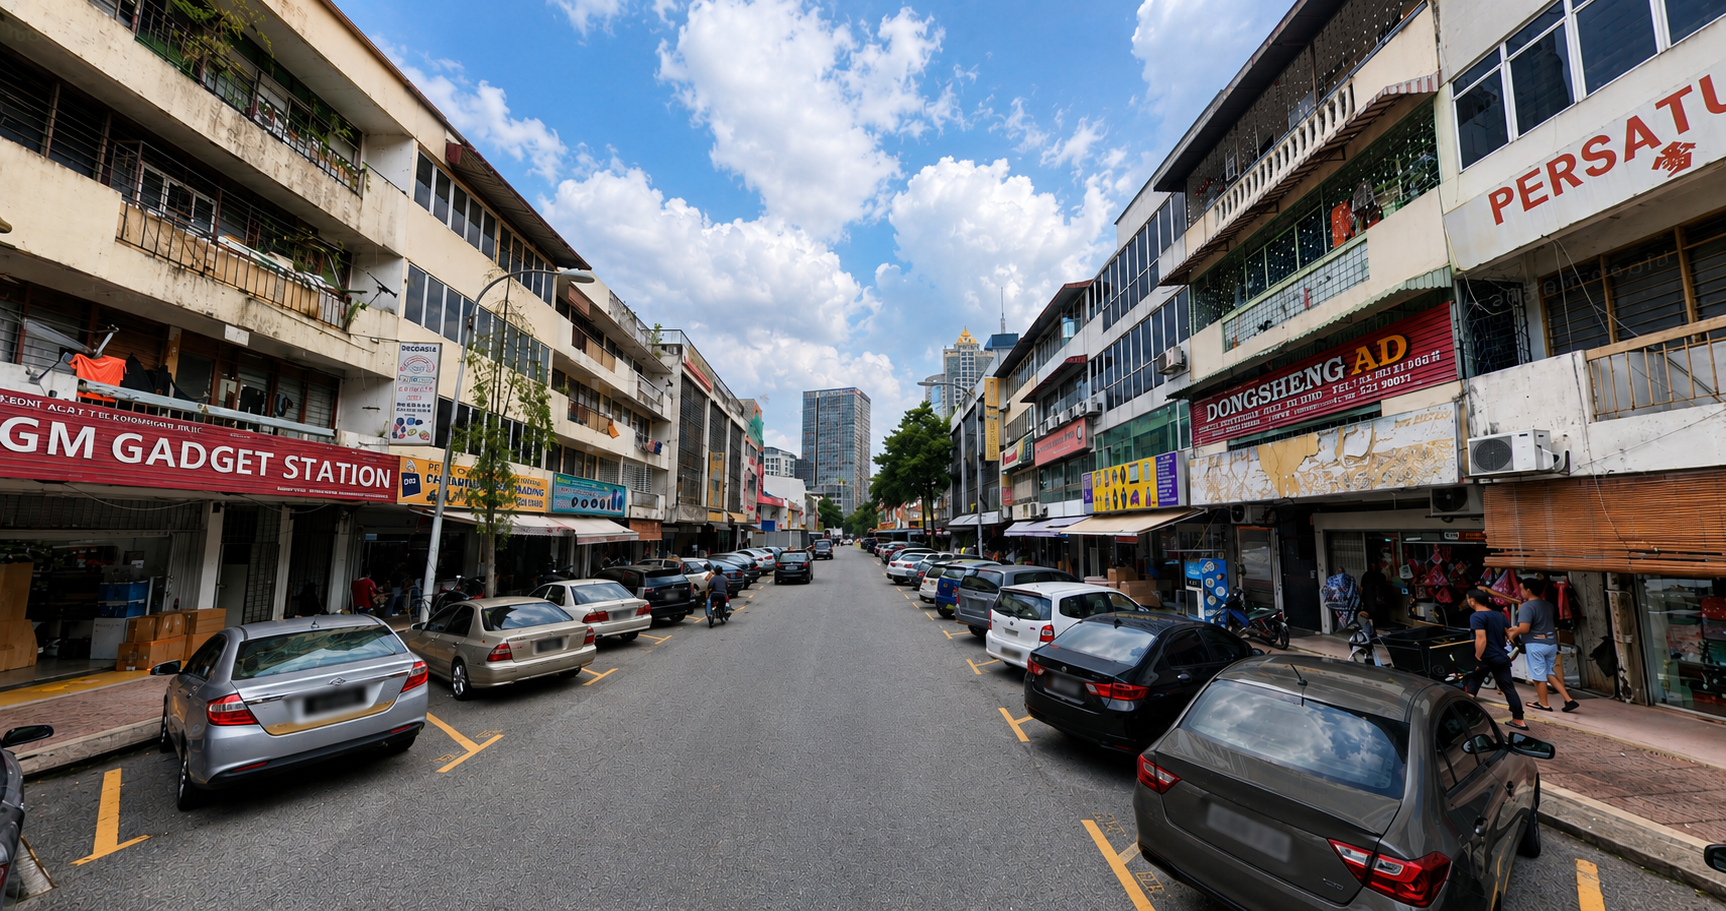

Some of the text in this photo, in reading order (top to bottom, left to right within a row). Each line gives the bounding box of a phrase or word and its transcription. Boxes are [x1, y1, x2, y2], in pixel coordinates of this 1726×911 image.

[1488, 74, 1726, 226] PERSATU
[1205, 355, 1345, 423] DONGSHENG
[1351, 334, 1408, 376] AD
[0, 416, 96, 460] GM
[111, 432, 274, 477] GADGET
[282, 455, 391, 489] STATION
